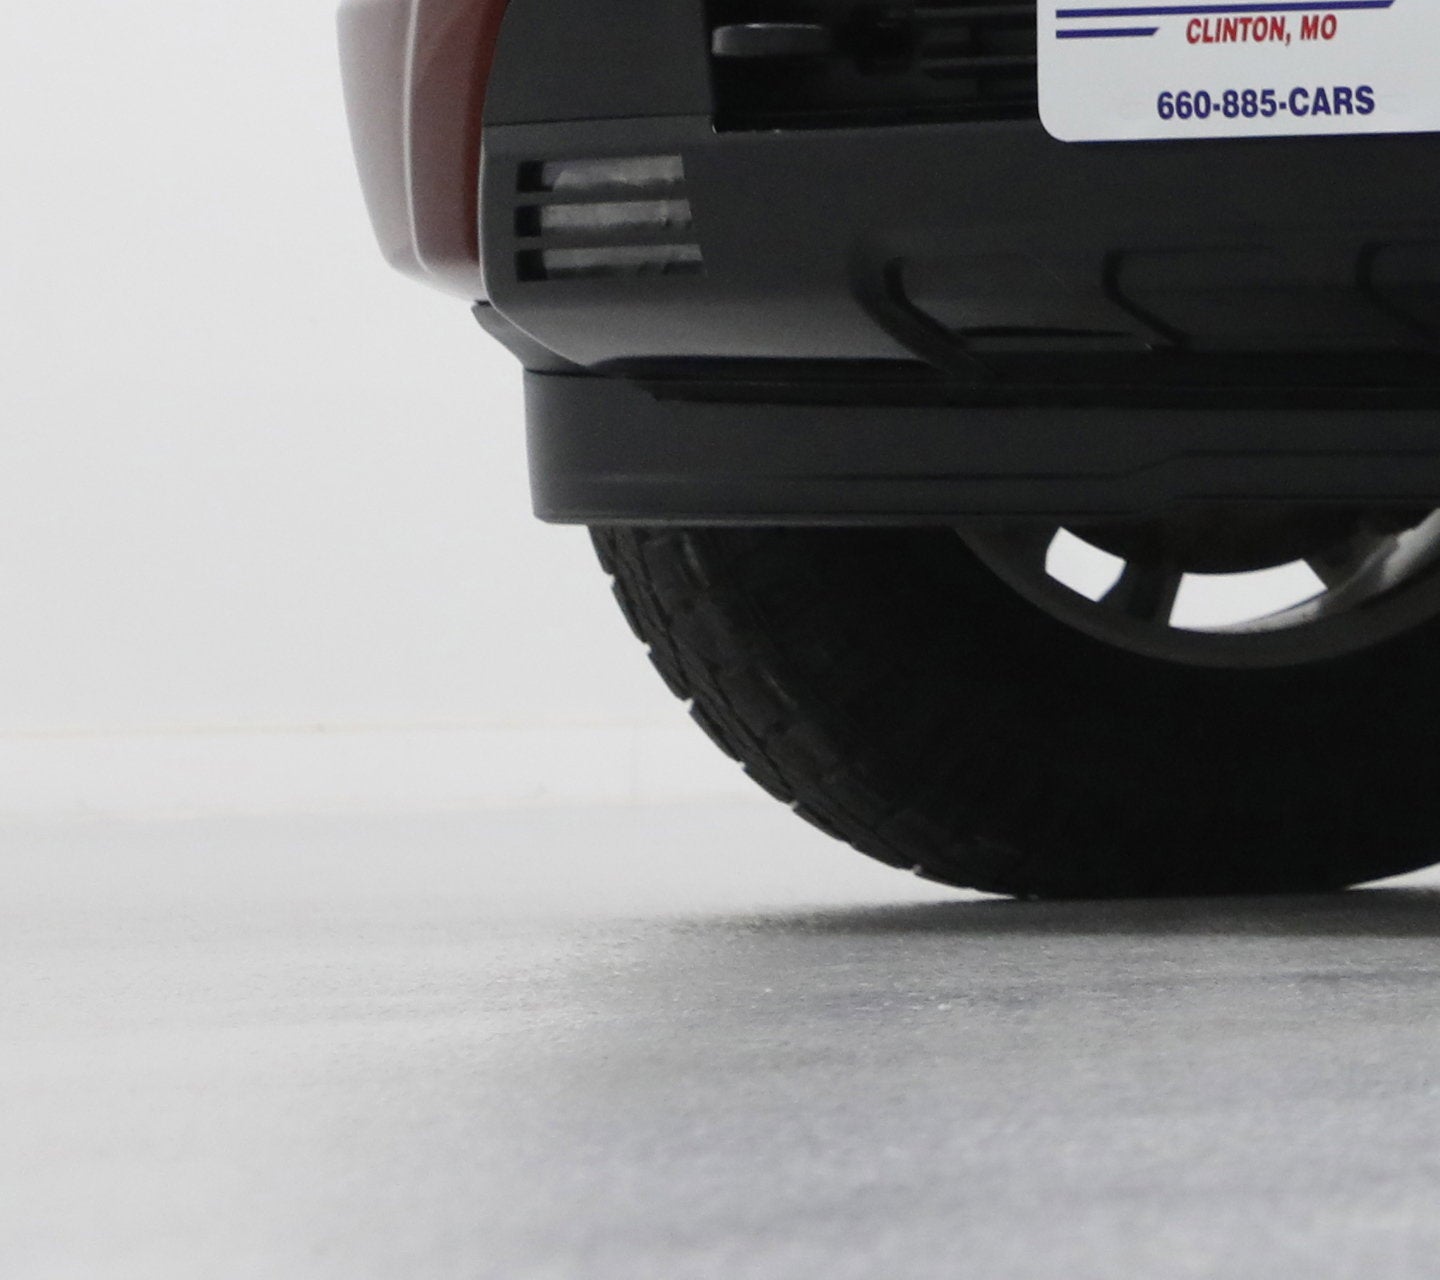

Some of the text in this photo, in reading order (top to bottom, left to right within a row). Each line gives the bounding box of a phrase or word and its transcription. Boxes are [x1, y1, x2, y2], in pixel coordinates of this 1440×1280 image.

[1186, 14, 1338, 46] CLINTON, MO
[1156, 85, 1376, 120] 660-885-CARS
